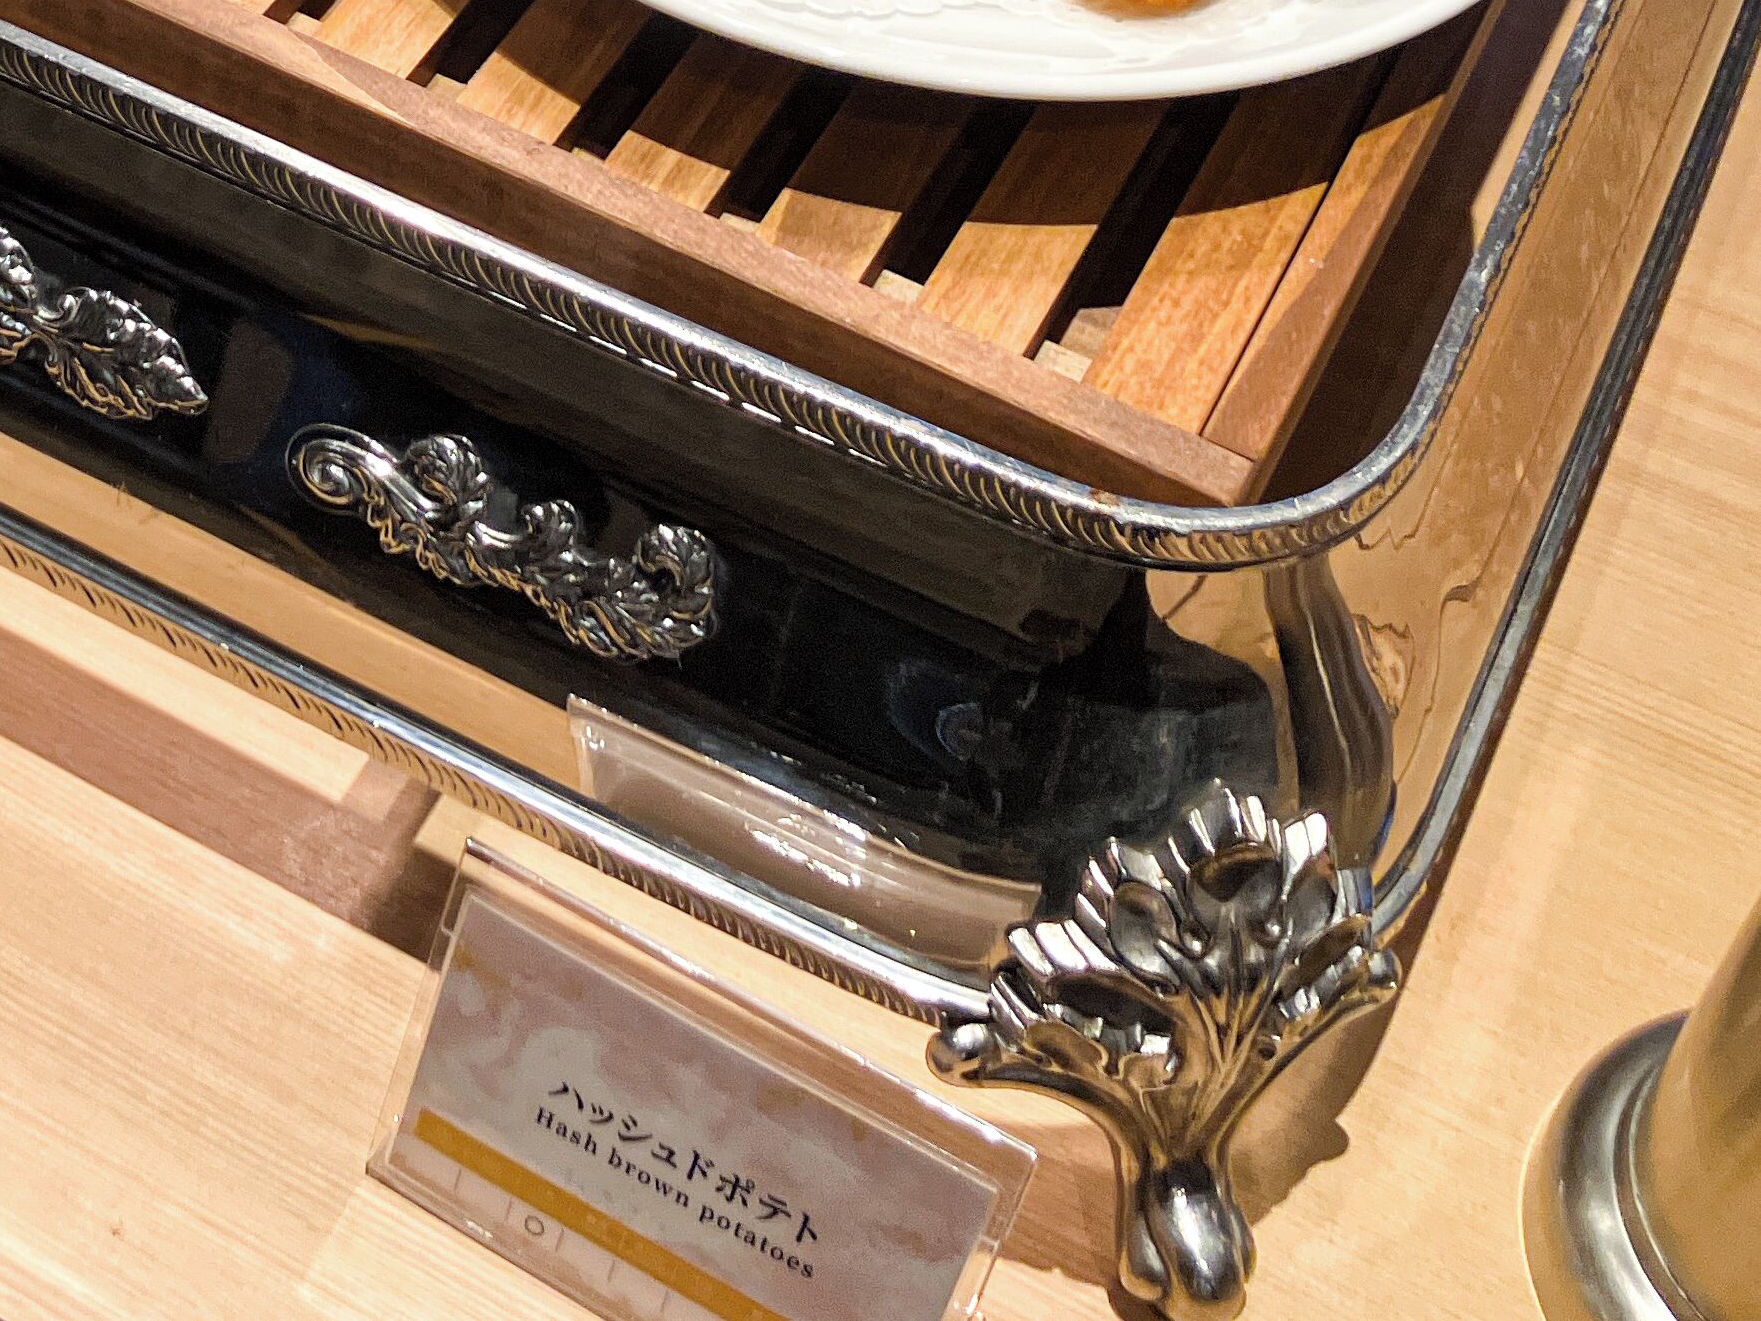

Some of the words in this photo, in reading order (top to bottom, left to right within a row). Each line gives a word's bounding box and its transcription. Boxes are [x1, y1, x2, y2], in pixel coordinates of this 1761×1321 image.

[536, 1106, 598, 1155] Hash
[607, 1146, 691, 1209] brown
[698, 1204, 815, 1279] potatoes
[547, 1081, 819, 1244] ハッシュドポテト
